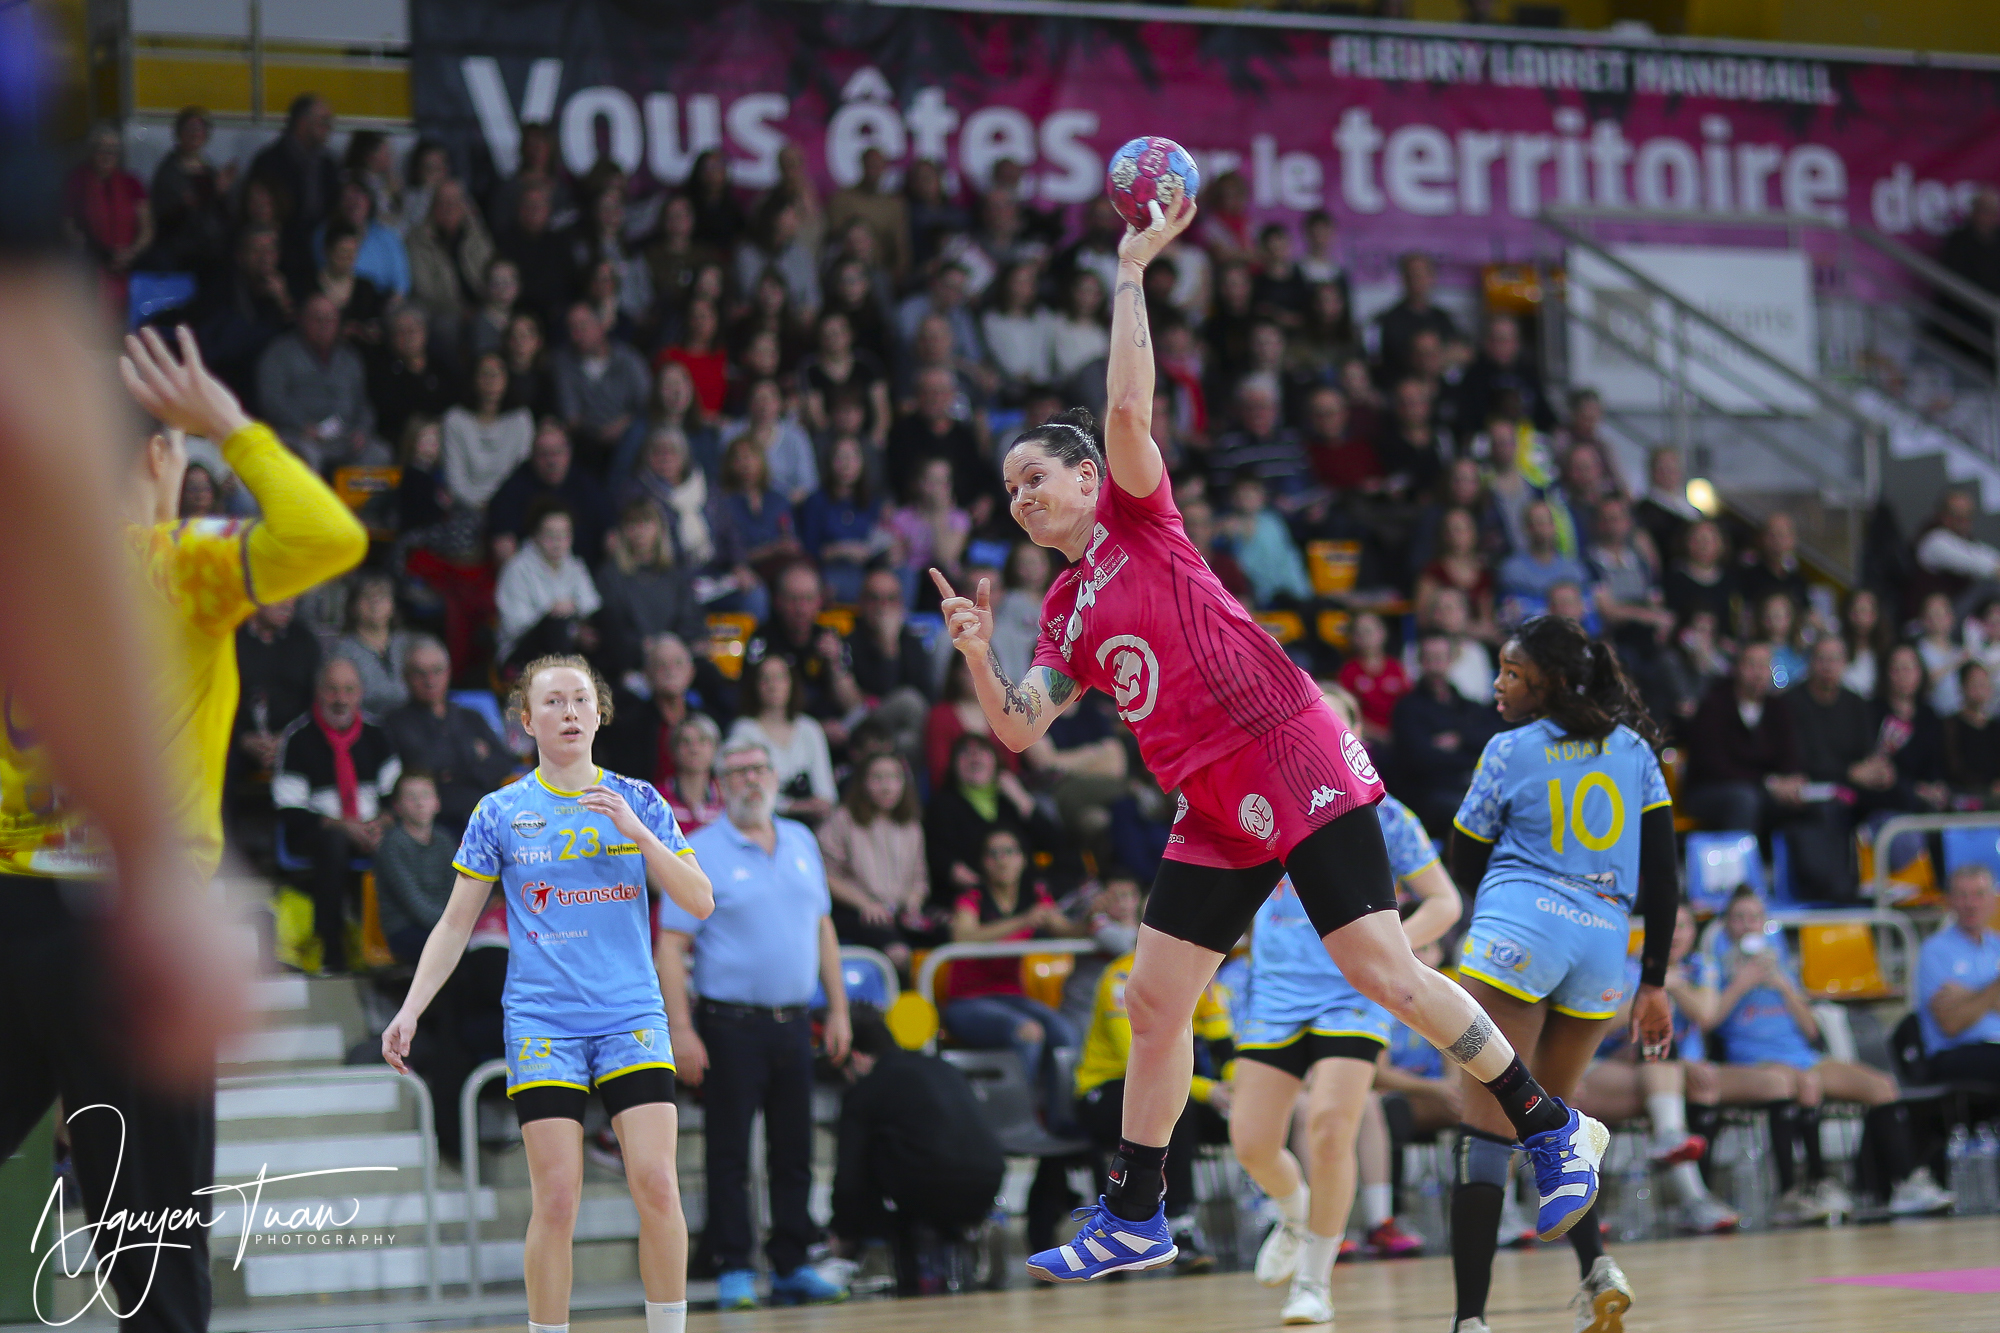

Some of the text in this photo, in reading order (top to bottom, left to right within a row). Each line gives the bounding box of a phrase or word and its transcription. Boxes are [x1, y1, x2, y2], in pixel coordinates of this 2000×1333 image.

[1330, 34, 1837, 106] FLEURY LOIRET HANDBALL
[461, 57, 1100, 201] Vous êtes
[1252, 134, 1324, 211] le
[1334, 106, 1848, 226] territoire
[558, 827, 601, 860] 23
[1547, 771, 1625, 854] 10
[555, 881, 642, 906] transdev
[518, 1037, 551, 1062] 23
